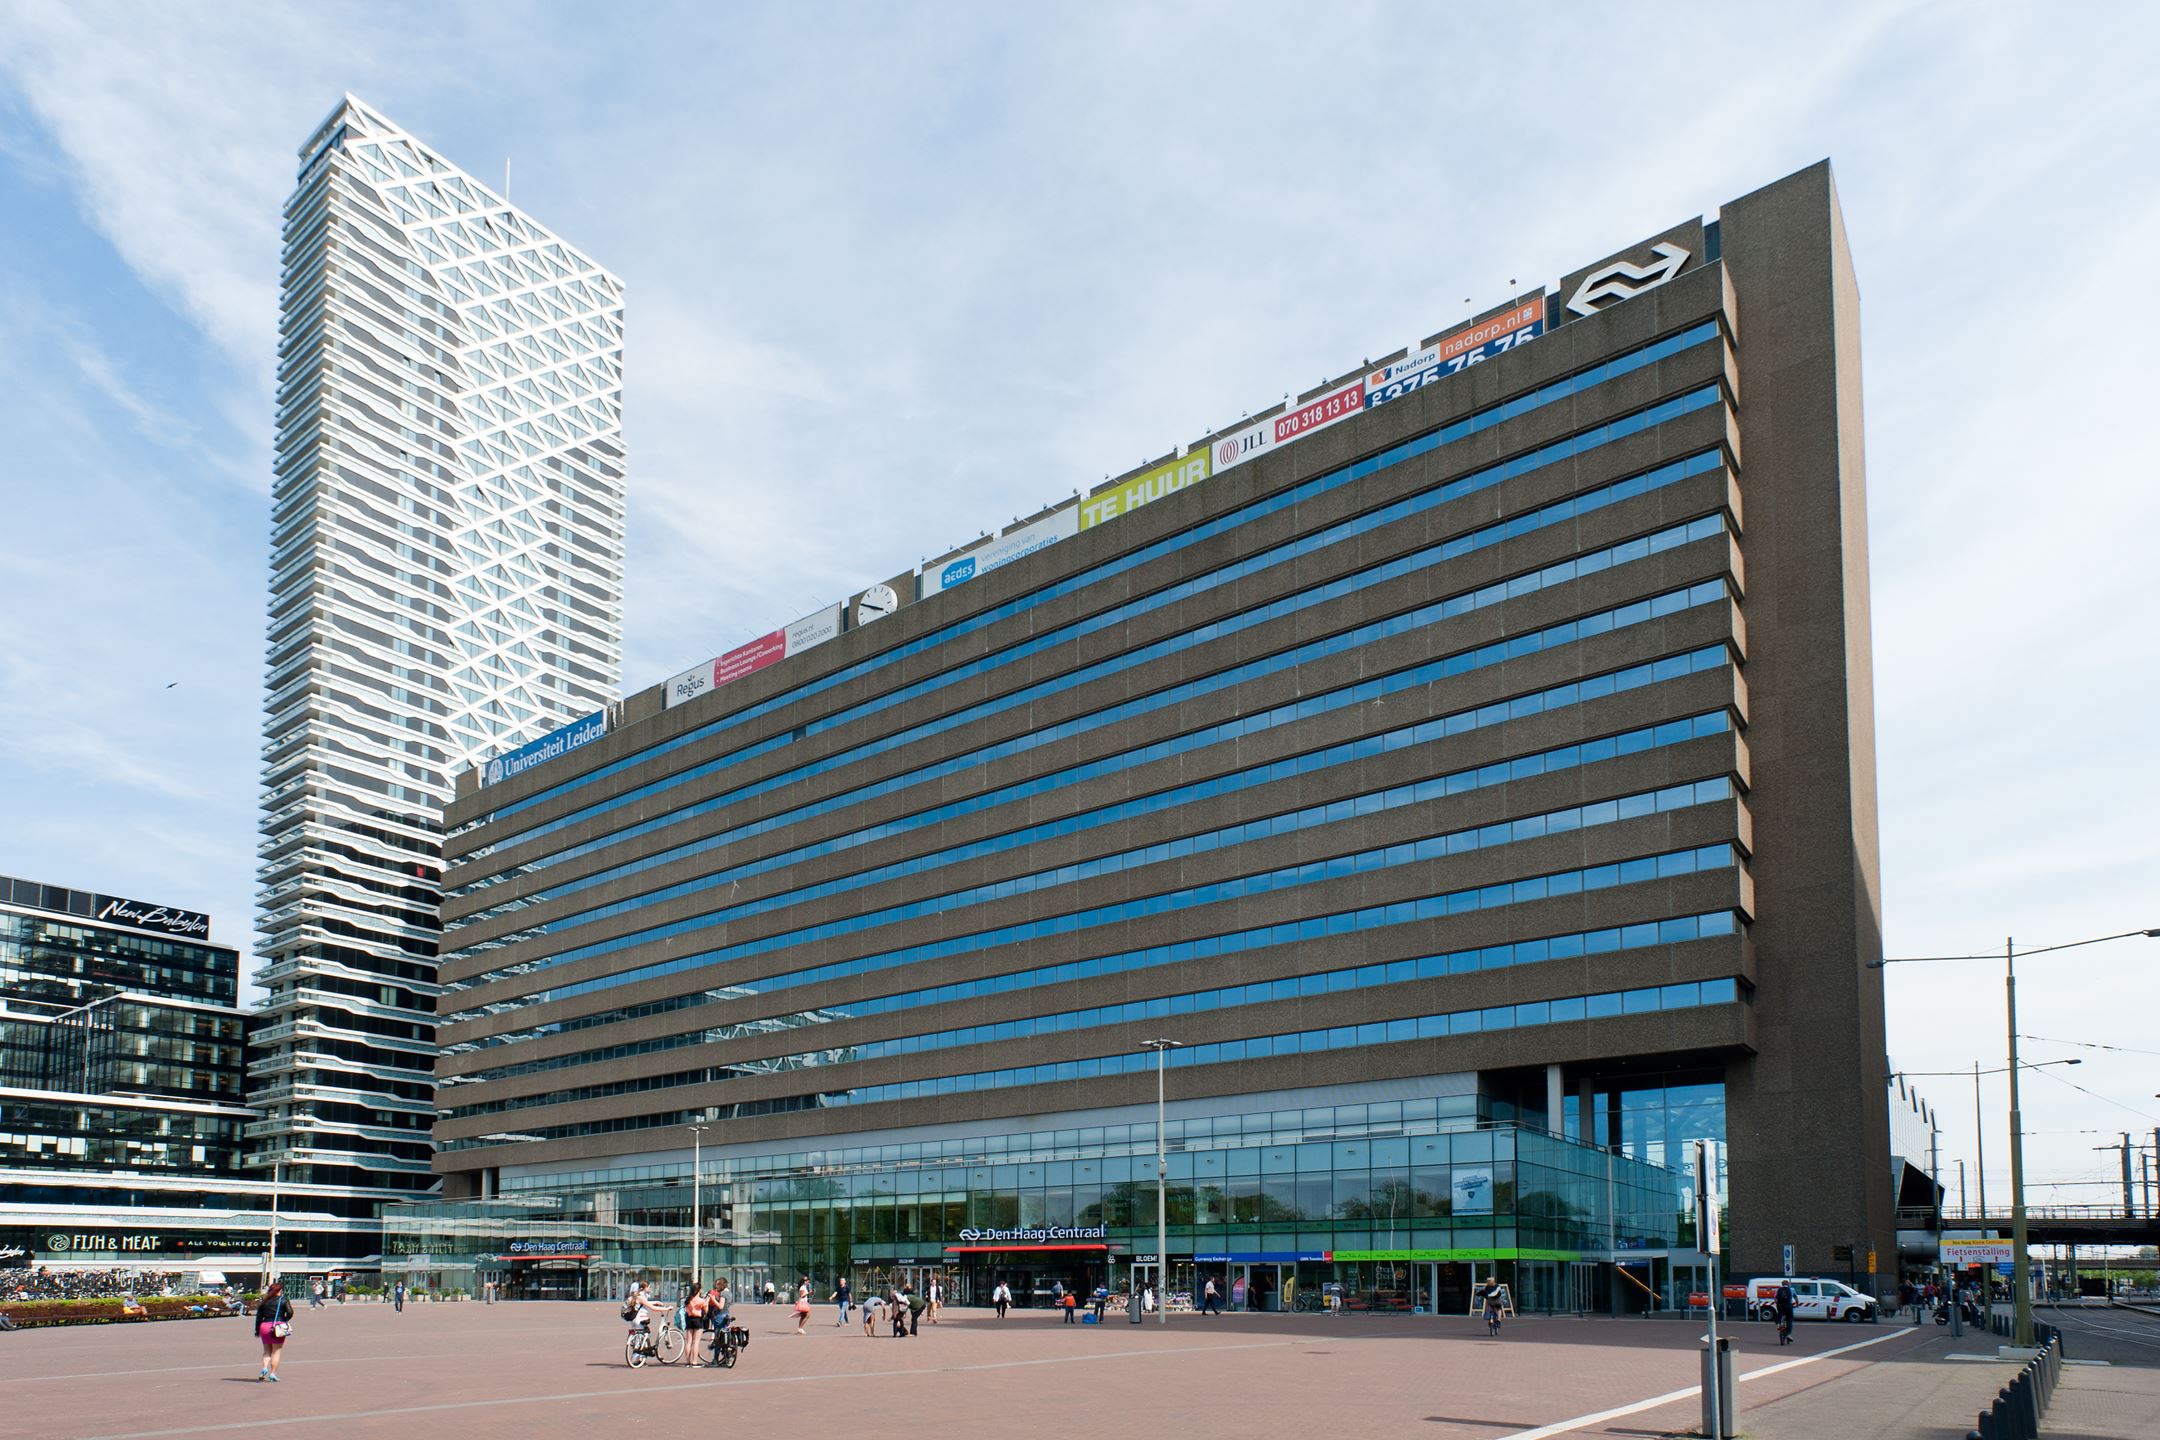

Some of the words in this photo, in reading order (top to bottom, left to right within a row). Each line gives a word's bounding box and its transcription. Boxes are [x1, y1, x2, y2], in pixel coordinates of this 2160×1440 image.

[1445, 312, 1521, 355] nadorp.nl
[1395, 351, 1436, 374] Nadorp
[1278, 416, 1299, 437] 070
[1302, 406, 1323, 427] 318
[1326, 399, 1340, 416] 13
[1344, 390, 1358, 408] 13
[1240, 430, 1268, 453] JLL
[1083, 495, 1119, 529] TE
[1126, 458, 1207, 512] HUUR
[677, 676, 705, 697] Regus
[504, 736, 565, 776] Universiteit
[566, 722, 603, 750] Leiden
[98, 900, 141, 919] New
[137, 907, 208, 932] Babylon
[73, 1234, 105, 1250] FISH
[108, 1237, 118, 1249] &
[122, 1235, 159, 1250] MEAT
[986, 1228, 1010, 1240] Den
[1014, 1227, 1046, 1242] Haag
[1049, 1224, 1104, 1240] Centraal
[524, 1243, 538, 1251] Den
[538, 1242, 556, 1253] Haag
[556, 1241, 586, 1251] Centraal
[1946, 1247, 2010, 1257] Fietsenstalling
